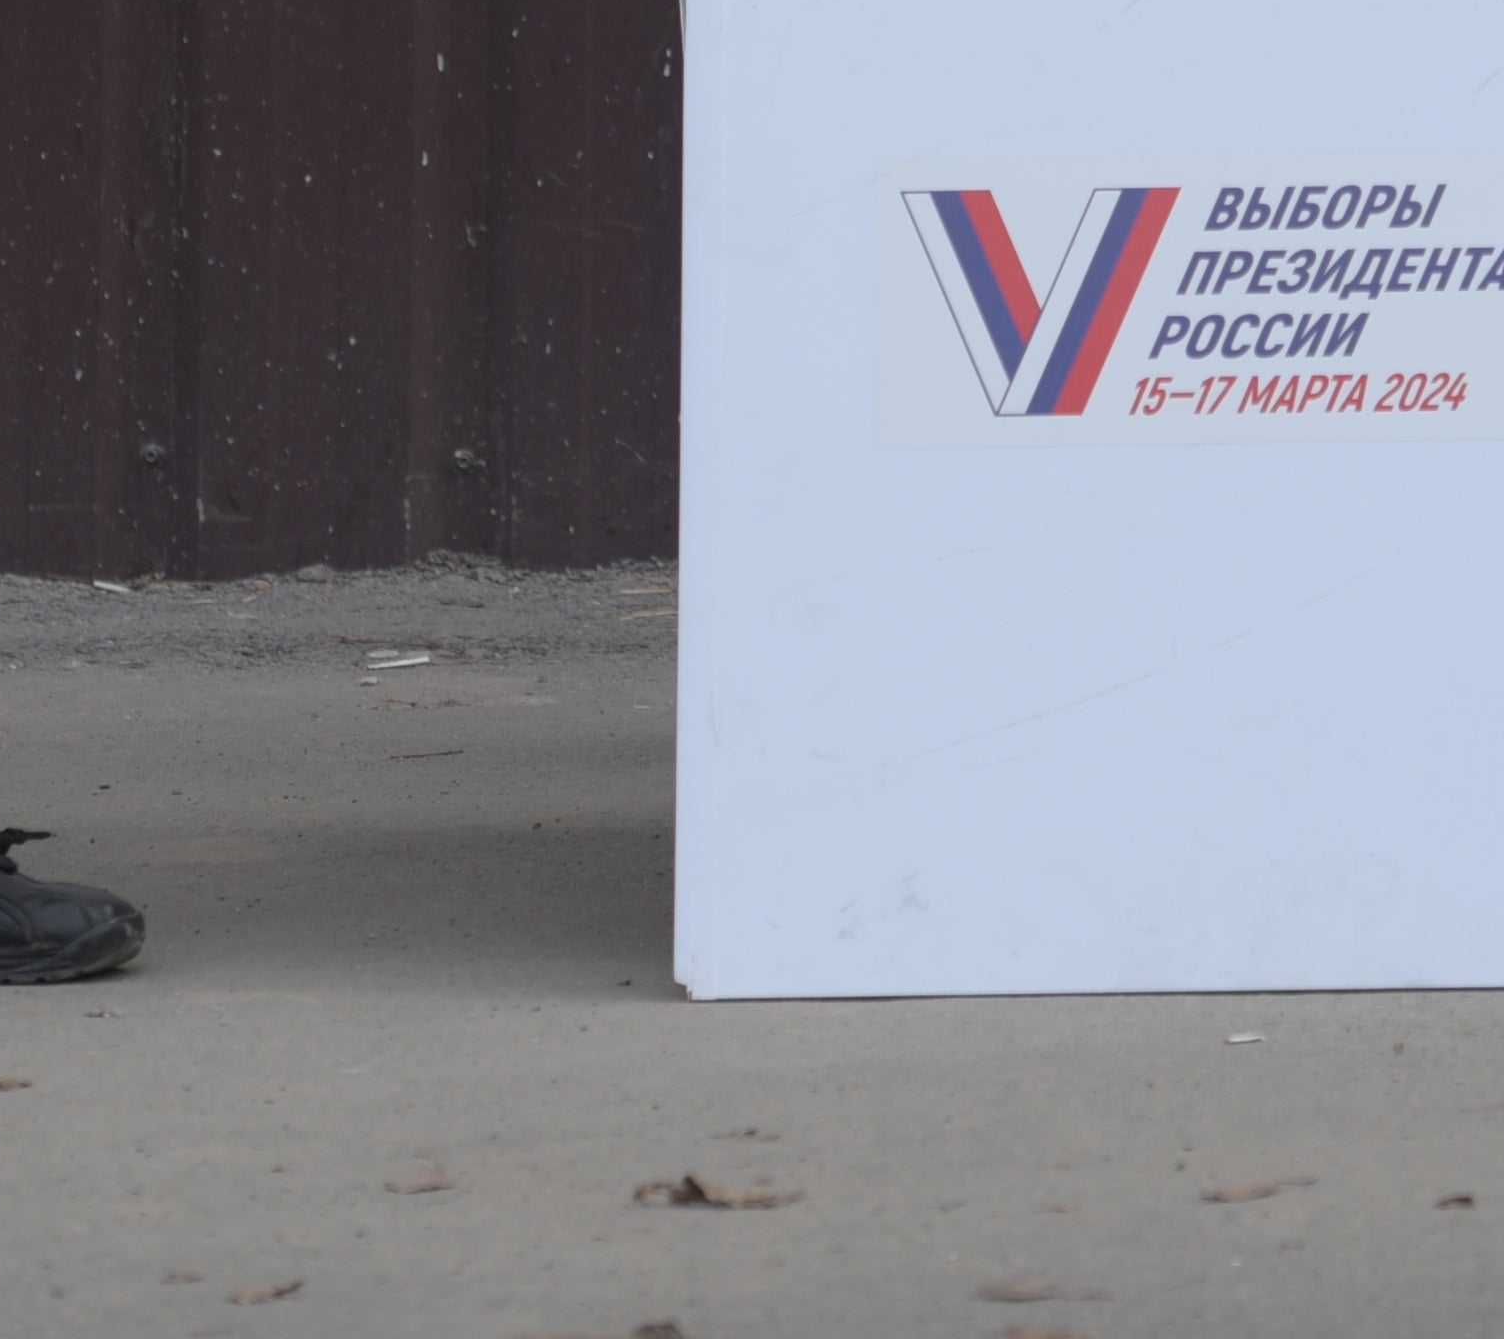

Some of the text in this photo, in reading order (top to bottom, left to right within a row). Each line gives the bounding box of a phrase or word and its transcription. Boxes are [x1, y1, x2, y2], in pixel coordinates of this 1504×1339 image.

[1204, 184, 1447, 231] ВЫБОРЫ
[1148, 313, 1369, 359] РОССИИ
[1129, 372, 1467, 416] 15–17 МАРТА 2024
